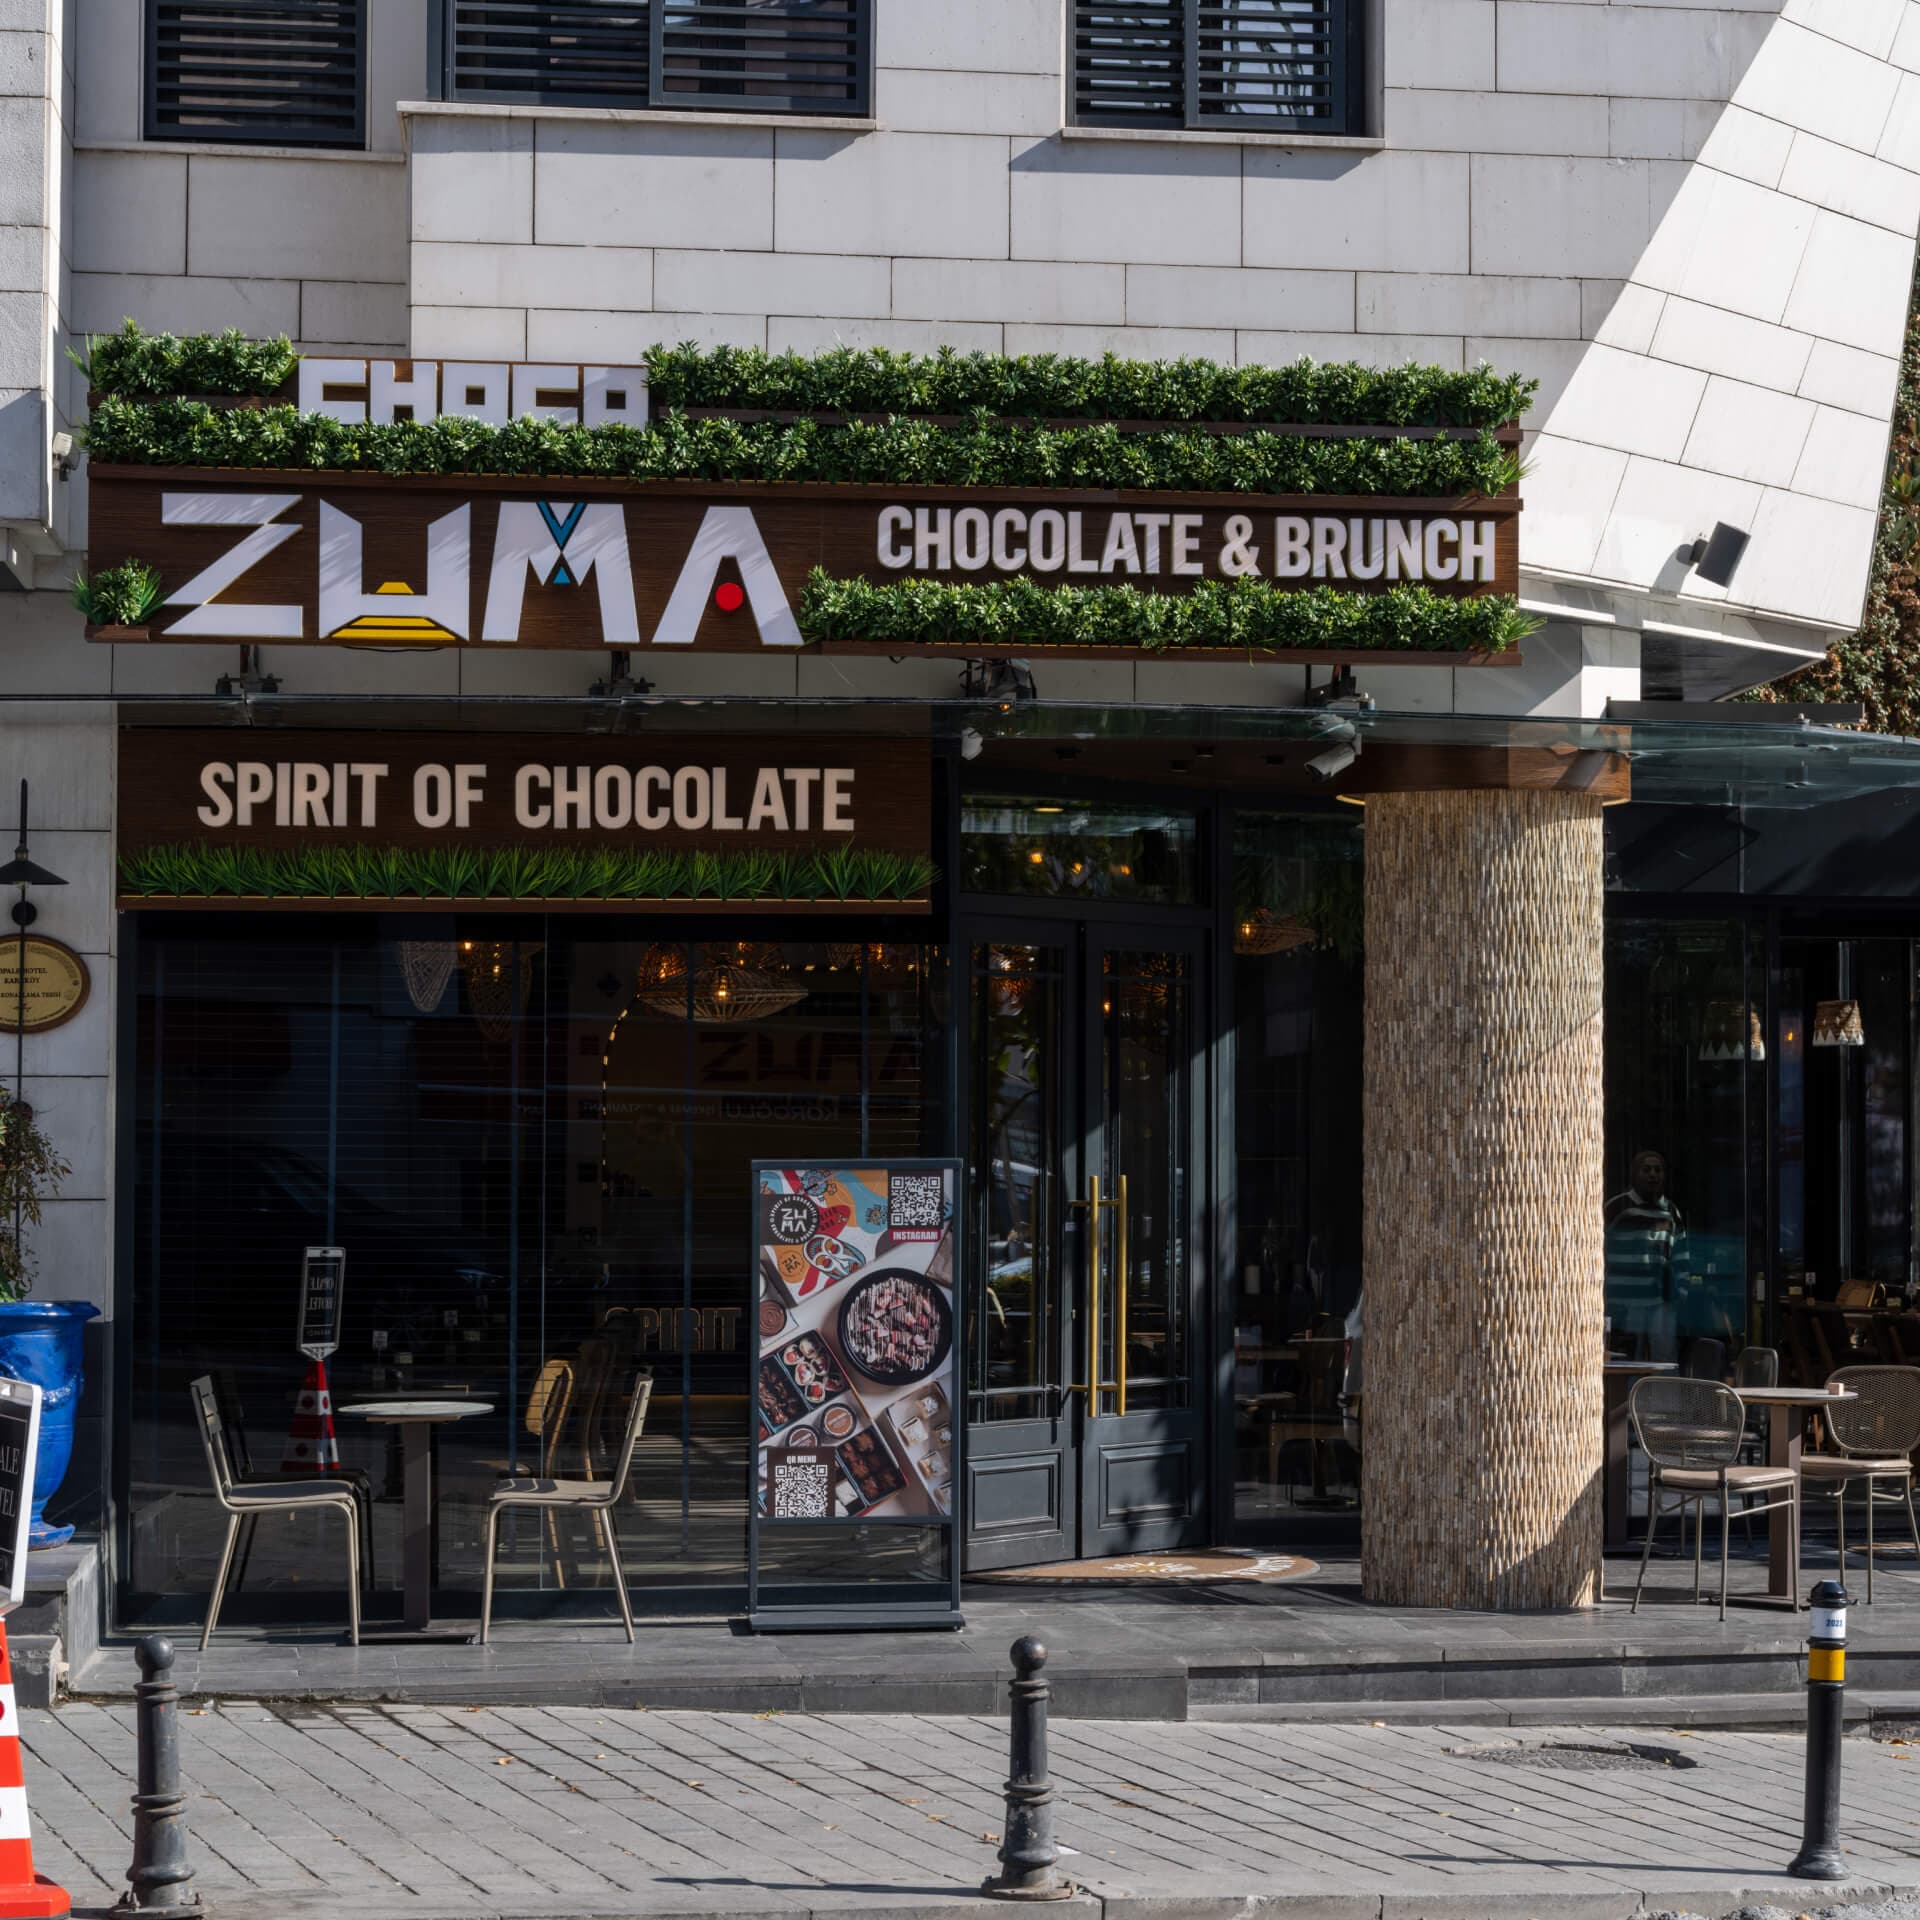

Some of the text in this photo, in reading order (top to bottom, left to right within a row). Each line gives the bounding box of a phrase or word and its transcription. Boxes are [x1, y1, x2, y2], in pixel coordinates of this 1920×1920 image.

[300, 359, 648, 429] CHOCO
[162, 493, 804, 647] ZUMA
[876, 504, 1497, 582] CHOCOLATE & BRUNCH
[197, 761, 856, 831] SPIRIT OF CHOCOLATE
[892, 1231, 938, 1240] INSTAGRAM
